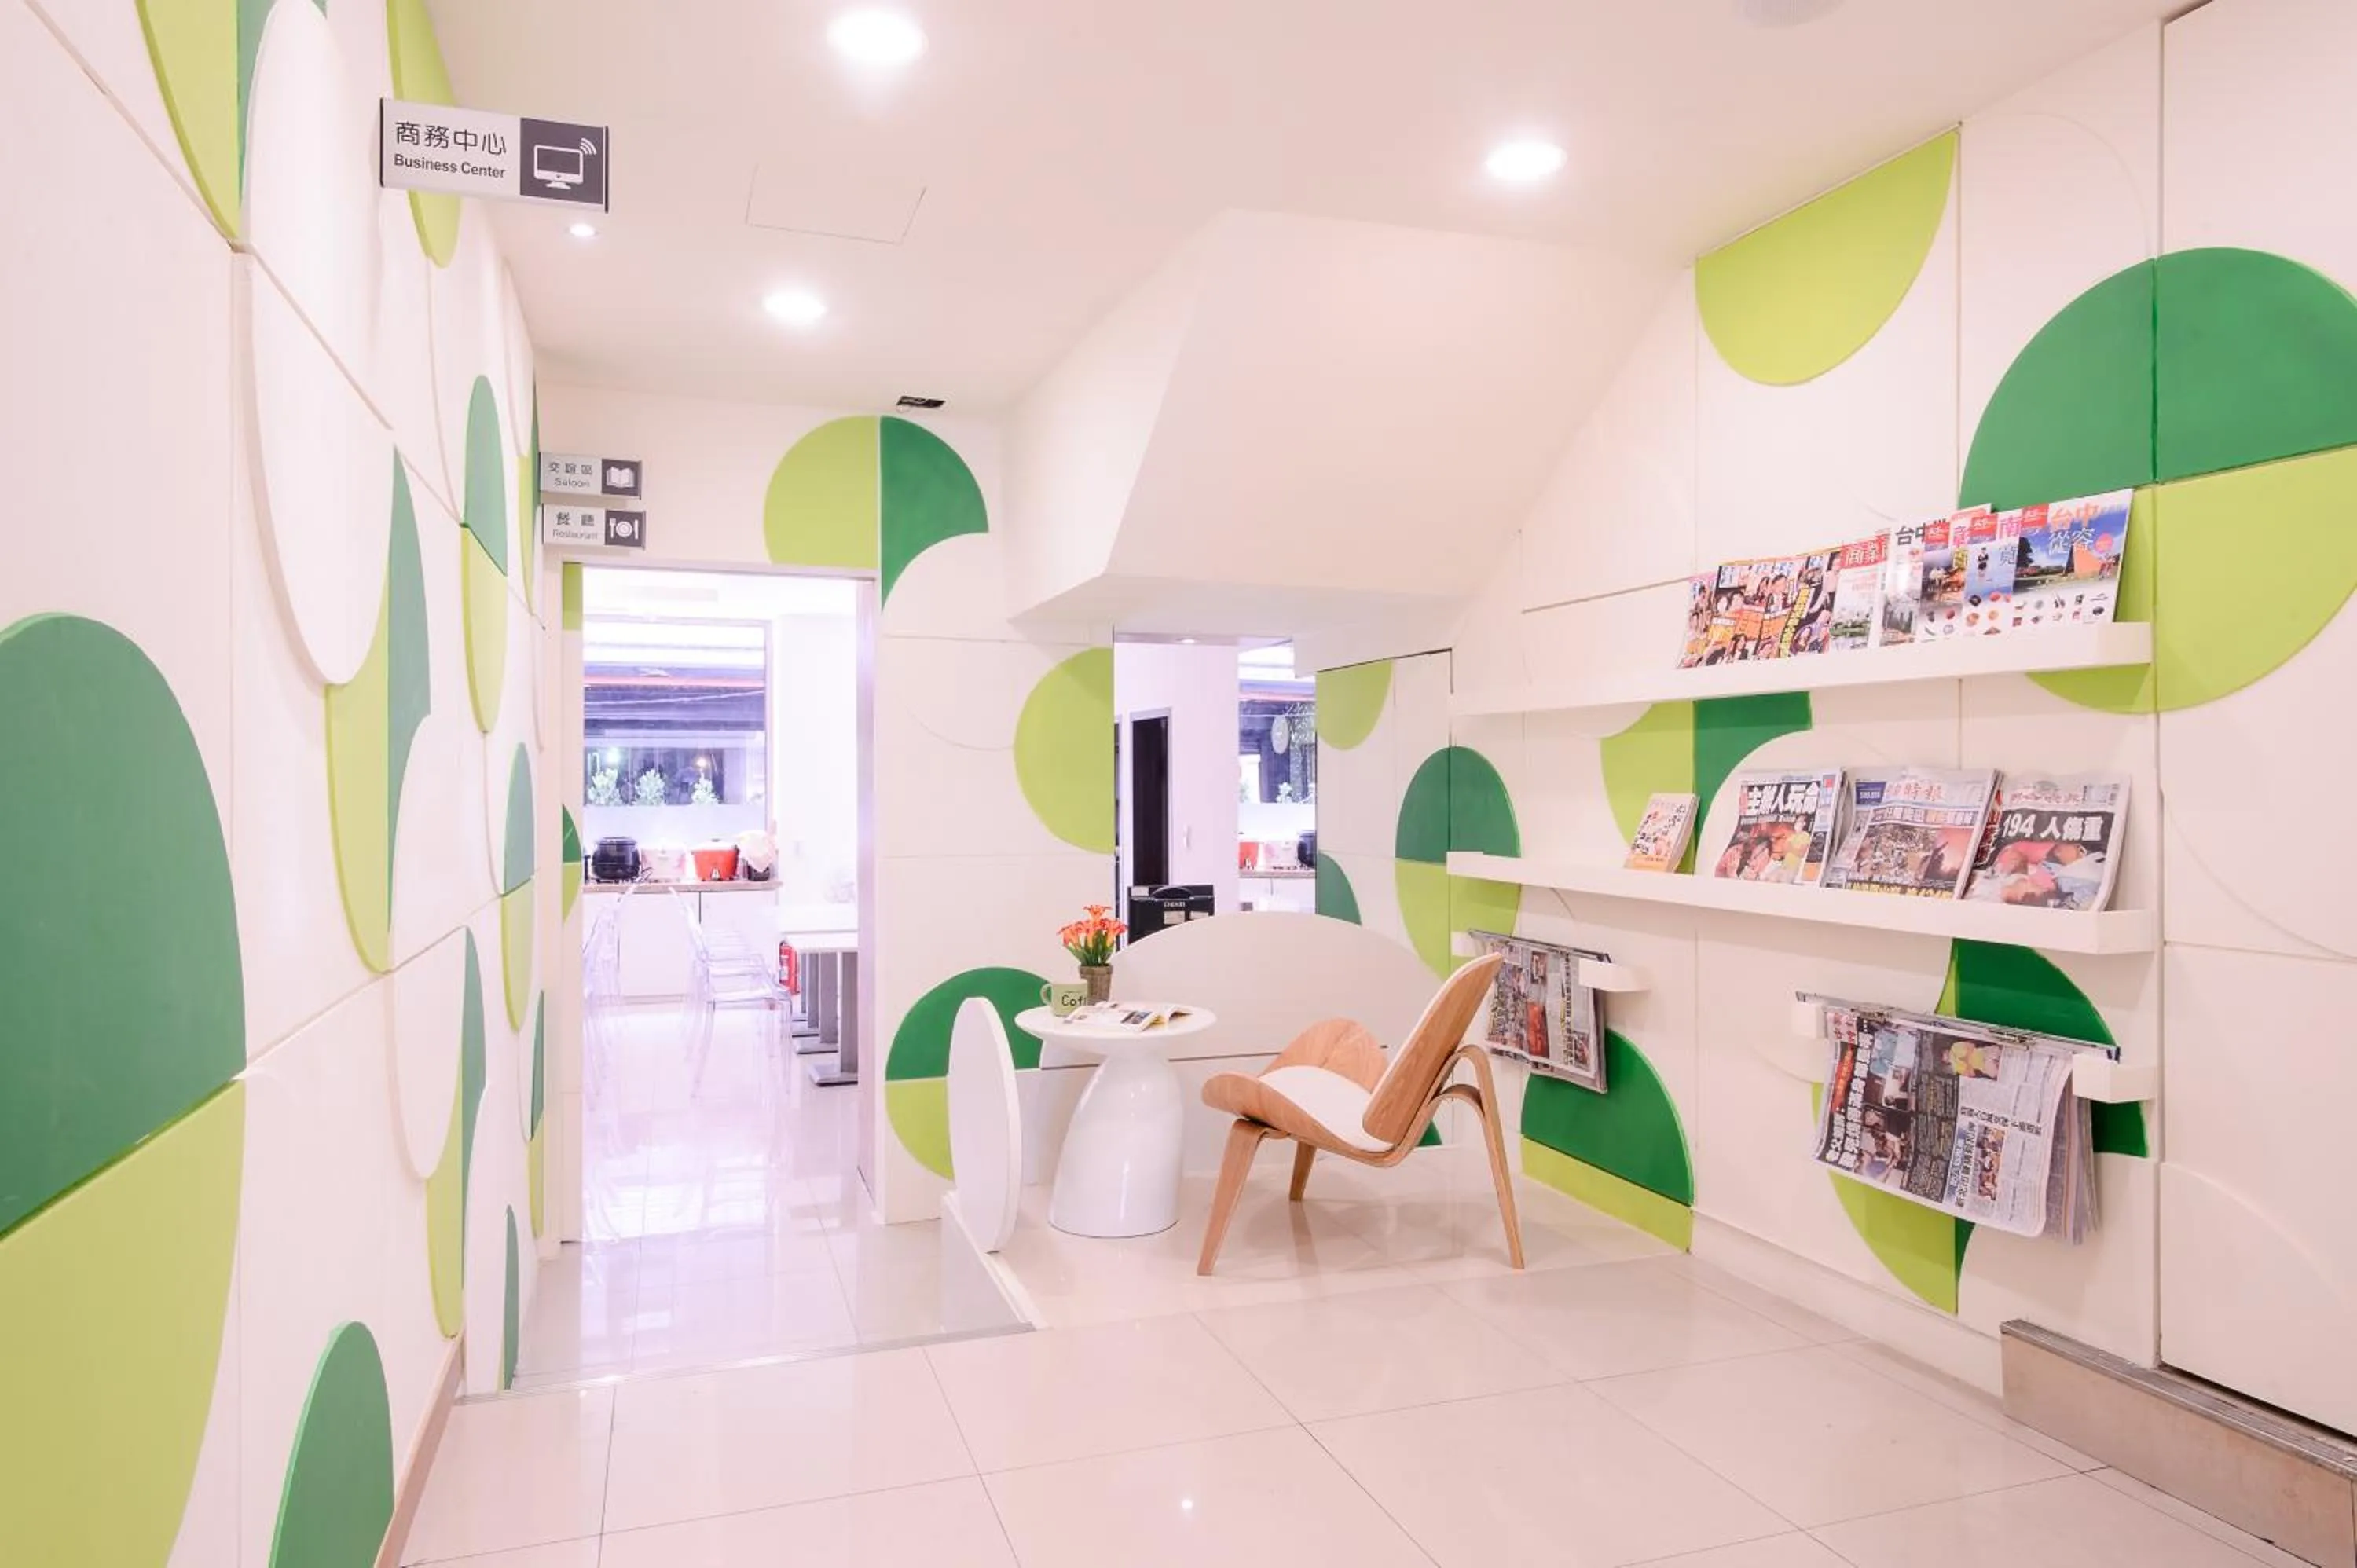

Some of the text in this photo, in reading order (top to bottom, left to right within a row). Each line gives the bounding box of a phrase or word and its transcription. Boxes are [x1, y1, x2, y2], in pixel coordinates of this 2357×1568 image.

[394, 121, 507, 156] 商務中心
[394, 154, 506, 178] Business Center
[2051, 503, 2100, 532] 台中
[1847, 540, 1887, 565] 商業
[2003, 813, 2036, 838] 194
